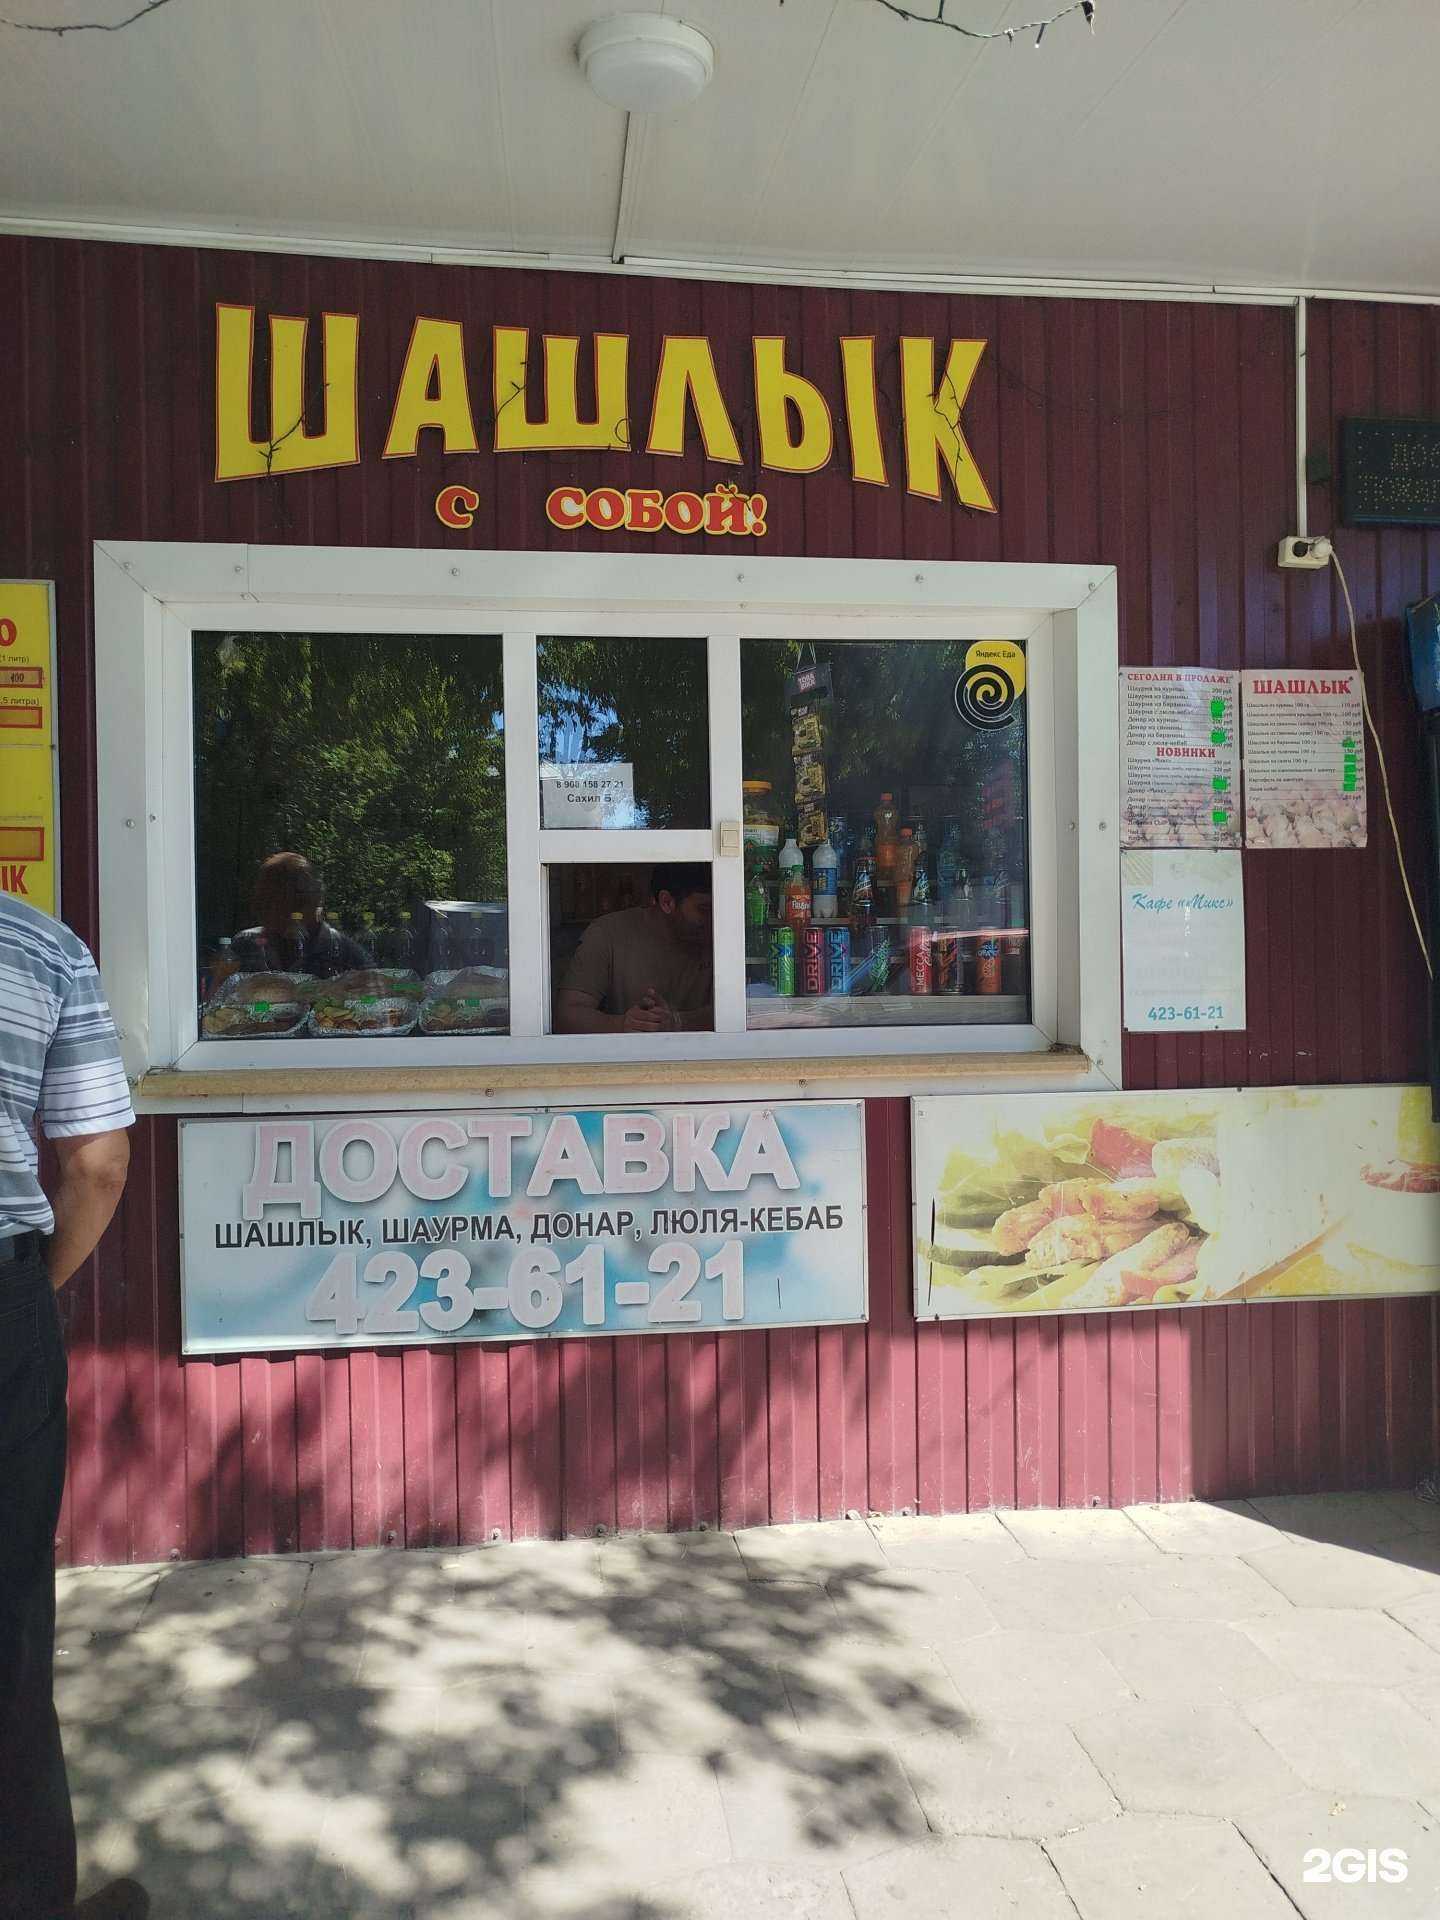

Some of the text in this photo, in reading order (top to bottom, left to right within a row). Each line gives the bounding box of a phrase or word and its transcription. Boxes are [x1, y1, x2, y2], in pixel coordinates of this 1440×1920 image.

[215, 302, 997, 514] ШАШЛЫК
[435, 482, 768, 537] С СОБОЙ!
[975, 650, 1016, 658] Яндекс Еда
[1253, 679, 1351, 694] ШАШЛЫК
[1157, 747, 1216, 758] НОВИНКИ
[1132, 893, 1172, 914] Кафе
[806, 930, 819, 991] DRIVE
[1147, 1005, 1224, 1021] 423-61-21
[242, 1110, 801, 1221] ДОСТАВКА
[214, 1204, 844, 1250] ШАШЛЫК, ШАУРМА, ДОНАР, ЛЮЛЯ-КЕБАБ
[305, 1239, 746, 1336] 423-61-21
